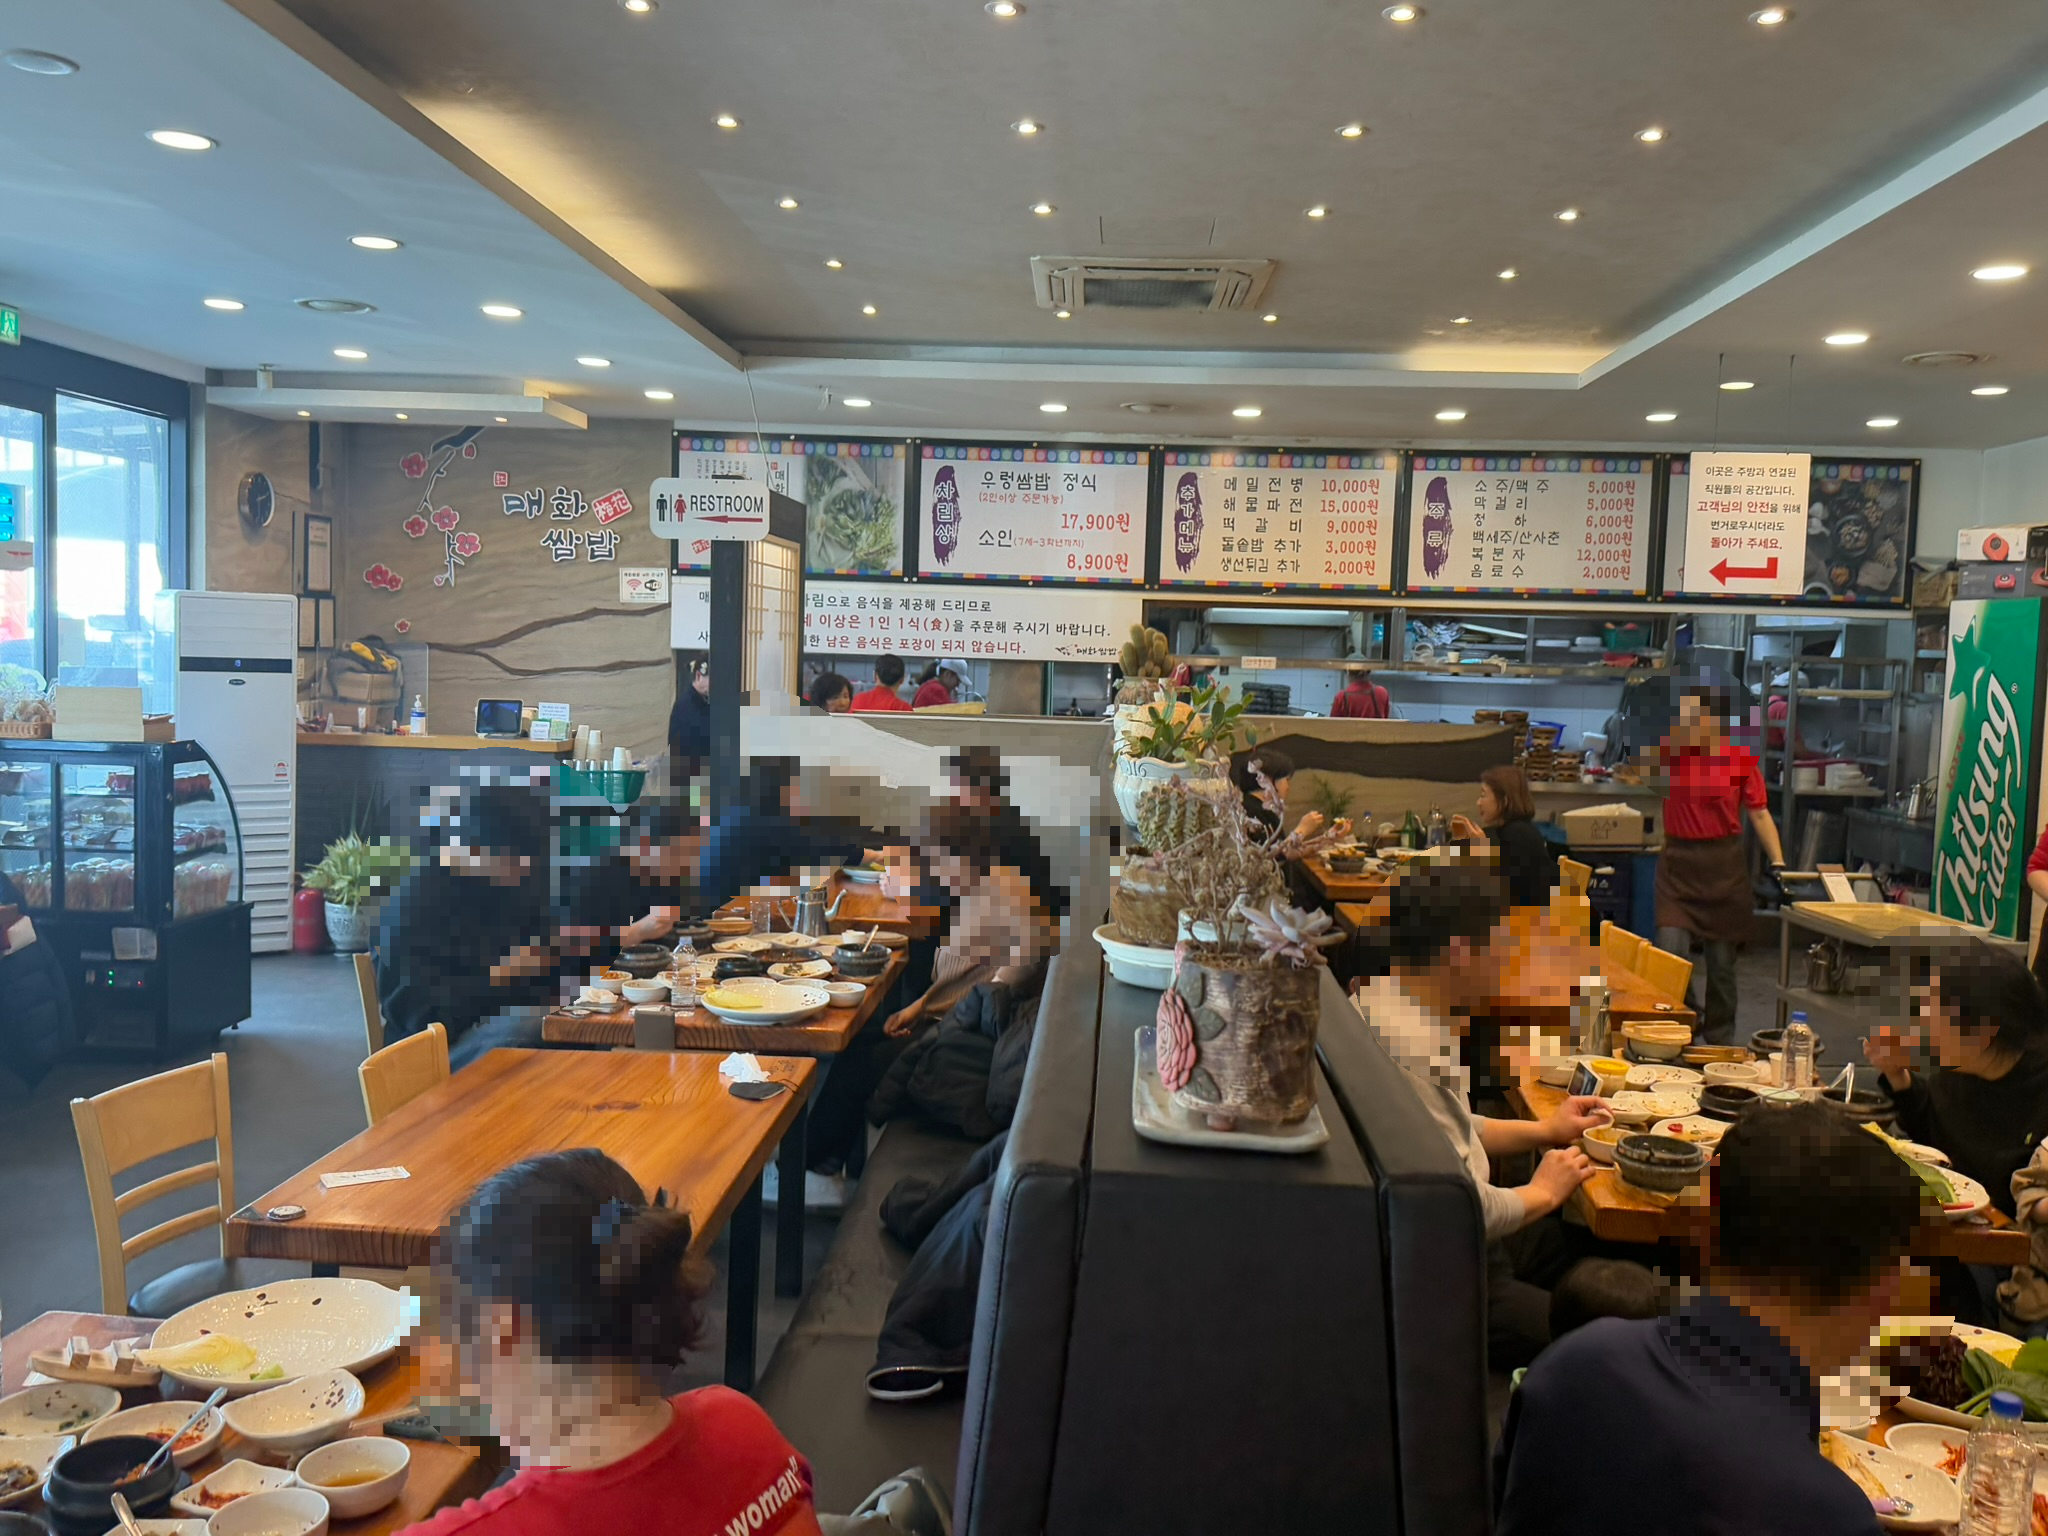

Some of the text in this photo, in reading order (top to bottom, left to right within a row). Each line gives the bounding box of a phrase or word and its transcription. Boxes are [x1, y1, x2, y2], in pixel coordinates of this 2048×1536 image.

[1705, 466, 1797, 478] 이곳은 주방과 연결된
[981, 471, 1096, 492] 우렁쌈밥 정식
[1321, 478, 1380, 495] 10,000원
[1588, 480, 1635, 495] 5,000원
[1705, 484, 1795, 496] 직원들의 공간입니다.
[503, 487, 588, 520] 매화
[690, 494, 764, 513] RESTROOM
[1320, 499, 1378, 515] 15,000원
[1587, 497, 1634, 512] 5,000원
[1697, 501, 1801, 514] 고객님의 안전을 위해
[1061, 513, 1130, 533] 17,900원
[1327, 519, 1377, 536] 9,000원
[1586, 514, 1633, 529] 6,000원
[1711, 520, 1785, 531] 번거로우시더라도
[541, 529, 620, 562] 쌈밥
[1222, 536, 1376, 556] 돌솥밥 추가 3,000원
[1585, 531, 1632, 546] 8,000원
[1711, 537, 1783, 550] 돌아가 주세요.
[1067, 553, 1129, 573] 8,900원
[1577, 548, 1631, 563] 12,000원
[1221, 557, 1375, 576] 생선튀김 추가 2,000원
[1583, 565, 1630, 580] 2,000원
[856, 596, 893, 610] 음식을
[899, 598, 935, 611] 제공해
[941, 599, 991, 613] 드리므로
[819, 614, 861, 629] 이상은
[869, 616, 890, 630] 1인
[970, 620, 1007, 633] 주문해
[1013, 622, 1049, 635] 주시기
[1056, 623, 1111, 637] 바랍니다.
[826, 635, 850, 648] 남은
[856, 636, 893, 650] 음식은
[899, 638, 935, 651] 포장이
[941, 639, 965, 653] 되지
[971, 640, 1026, 654] 않습니다.
